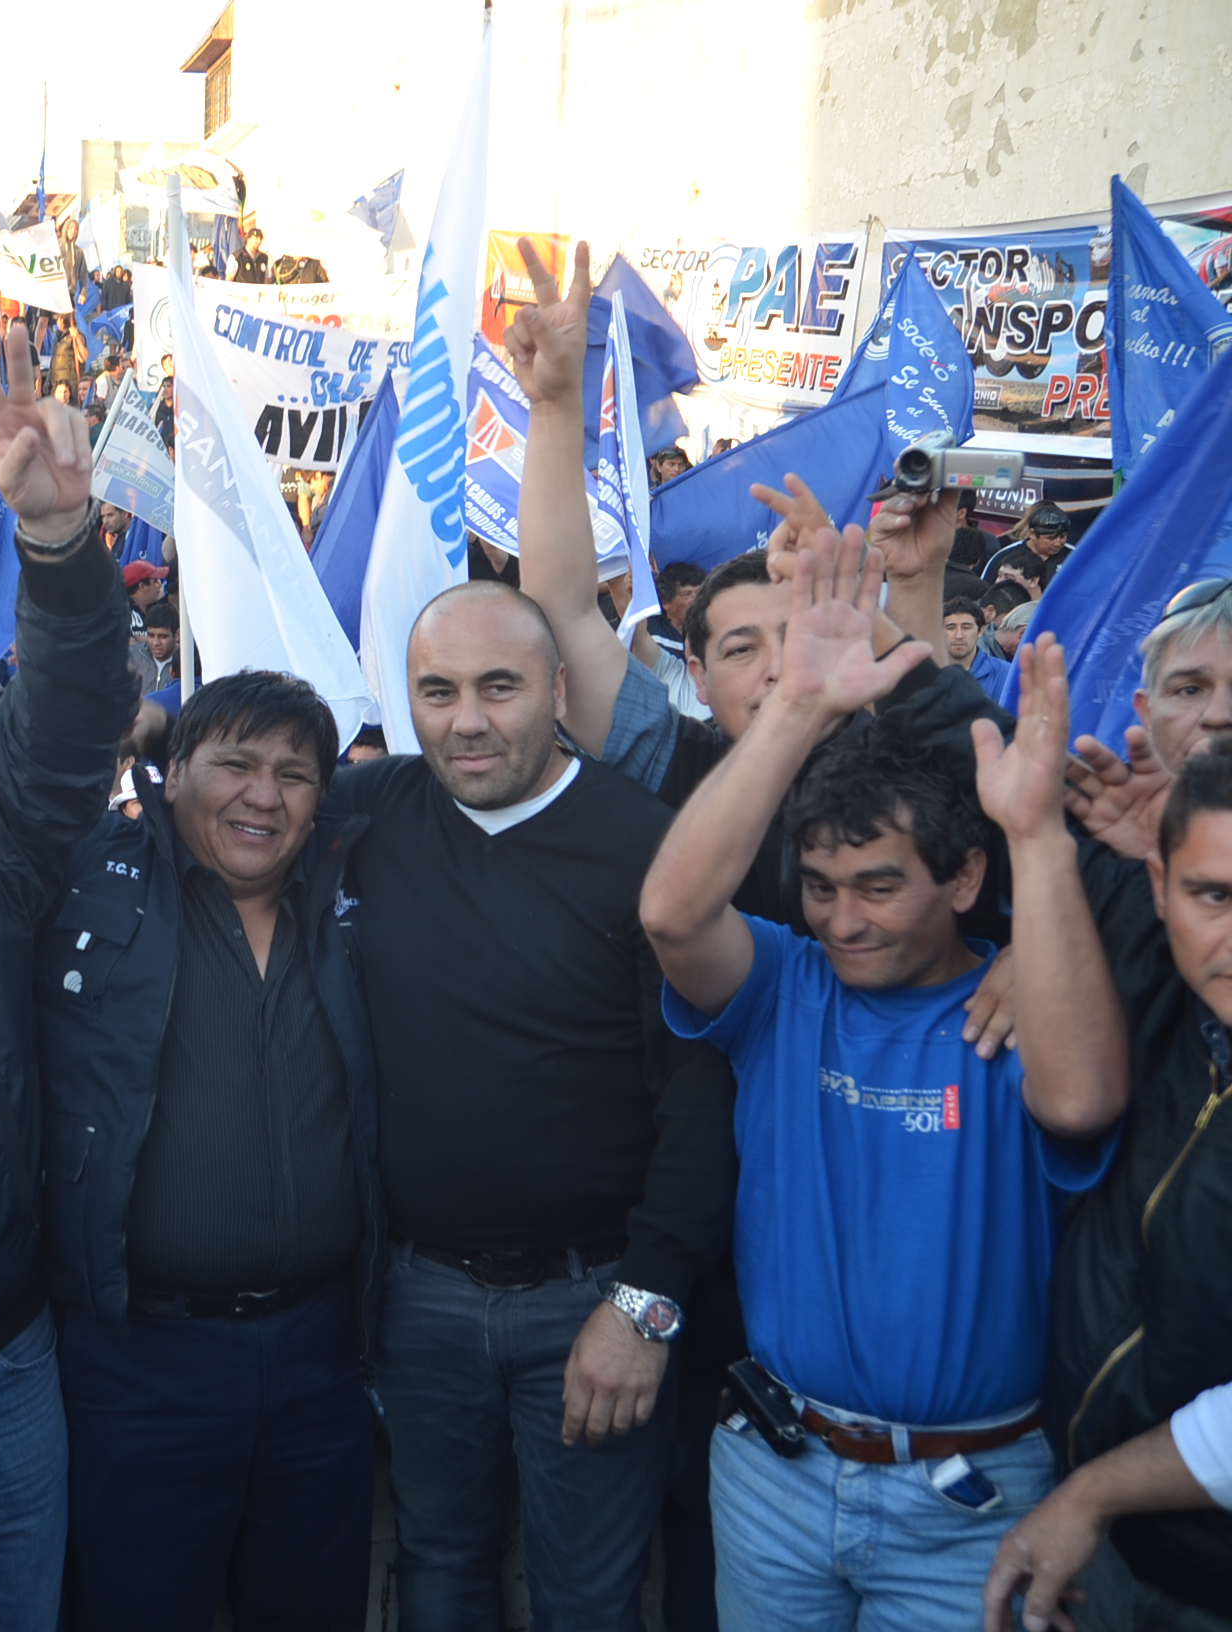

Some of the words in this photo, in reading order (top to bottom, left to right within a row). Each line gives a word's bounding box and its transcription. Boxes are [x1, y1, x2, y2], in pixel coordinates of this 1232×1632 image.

[640, 247, 710, 272] SECTOR
[887, 245, 1031, 290] SCTOR
[725, 242, 859, 337] PAE
[213, 304, 326, 368] CONTROL
[348, 339, 379, 372] DE
[896, 318, 949, 382] sodexo
[719, 346, 841, 393] PRESENTE
[466, 482, 506, 521] CARLOS
